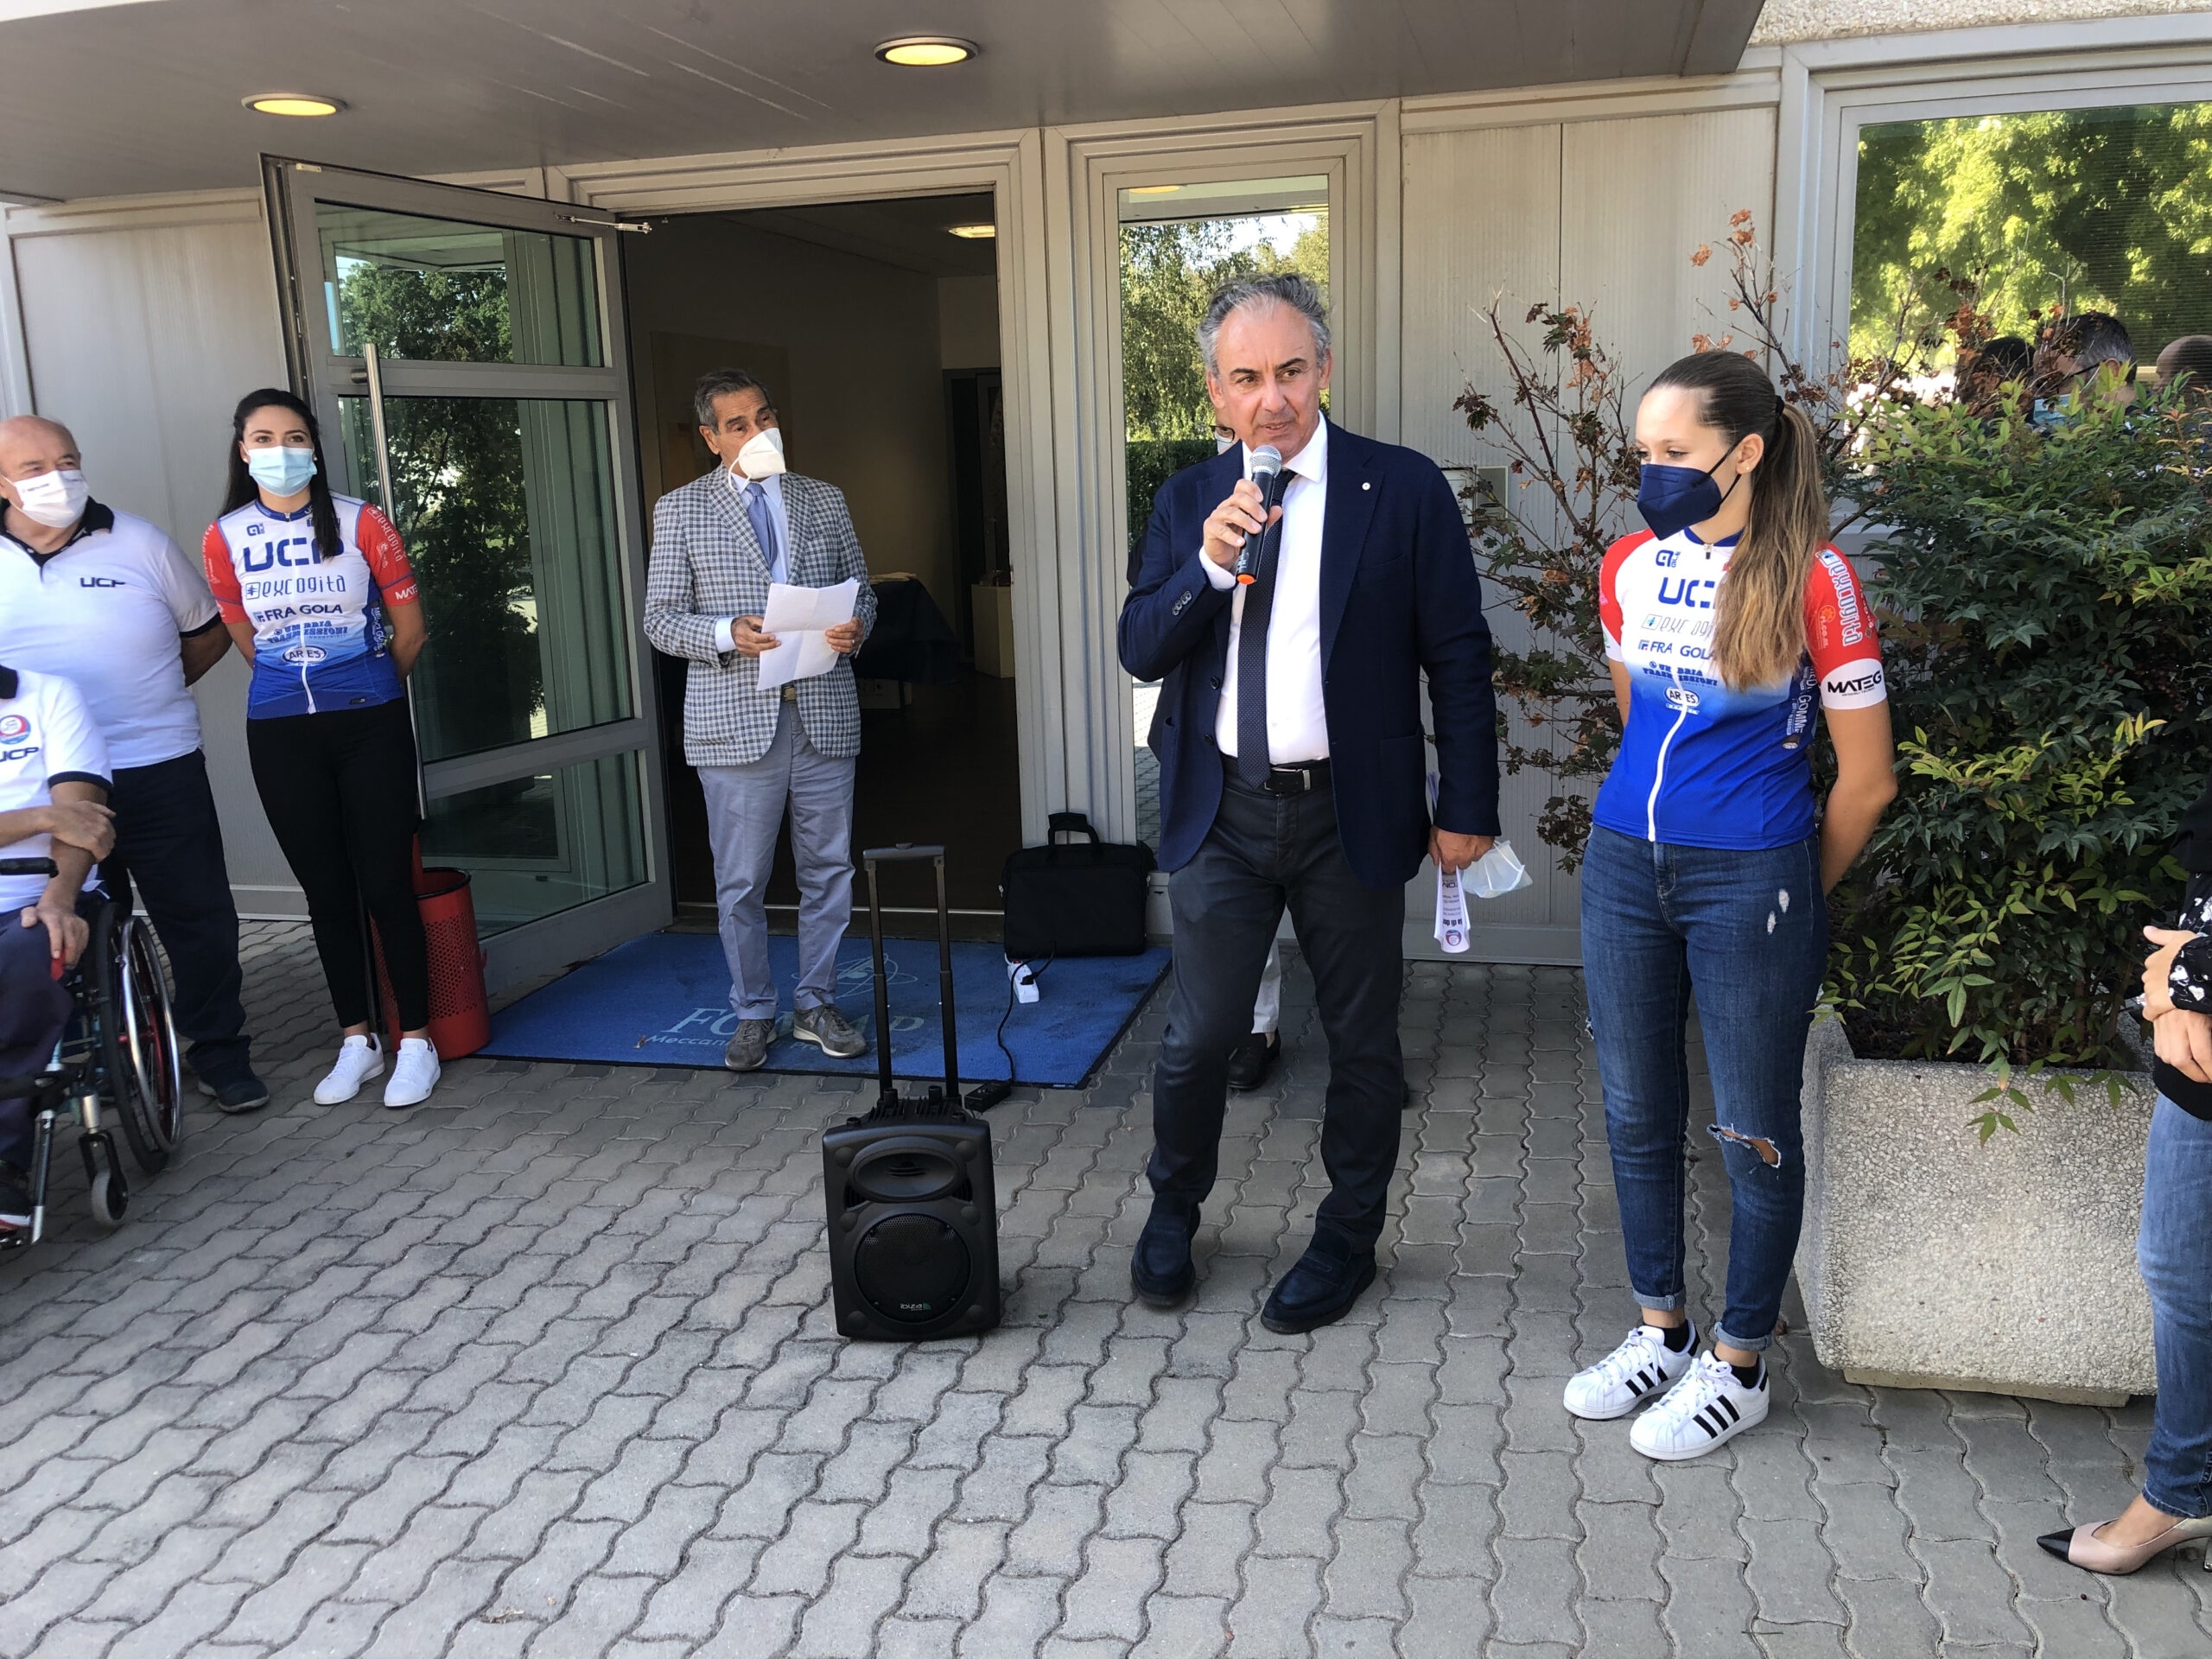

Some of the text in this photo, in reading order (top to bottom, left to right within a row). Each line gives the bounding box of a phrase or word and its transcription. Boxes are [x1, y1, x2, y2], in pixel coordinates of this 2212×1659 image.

[395, 583, 418, 601] MATE
[1657, 576, 1716, 609] UC
[289, 650, 321, 659] ARES
[1827, 670, 1882, 694] MATEG
[1669, 690, 1696, 704] ARES
[645, 1035, 728, 1046] Meccan
